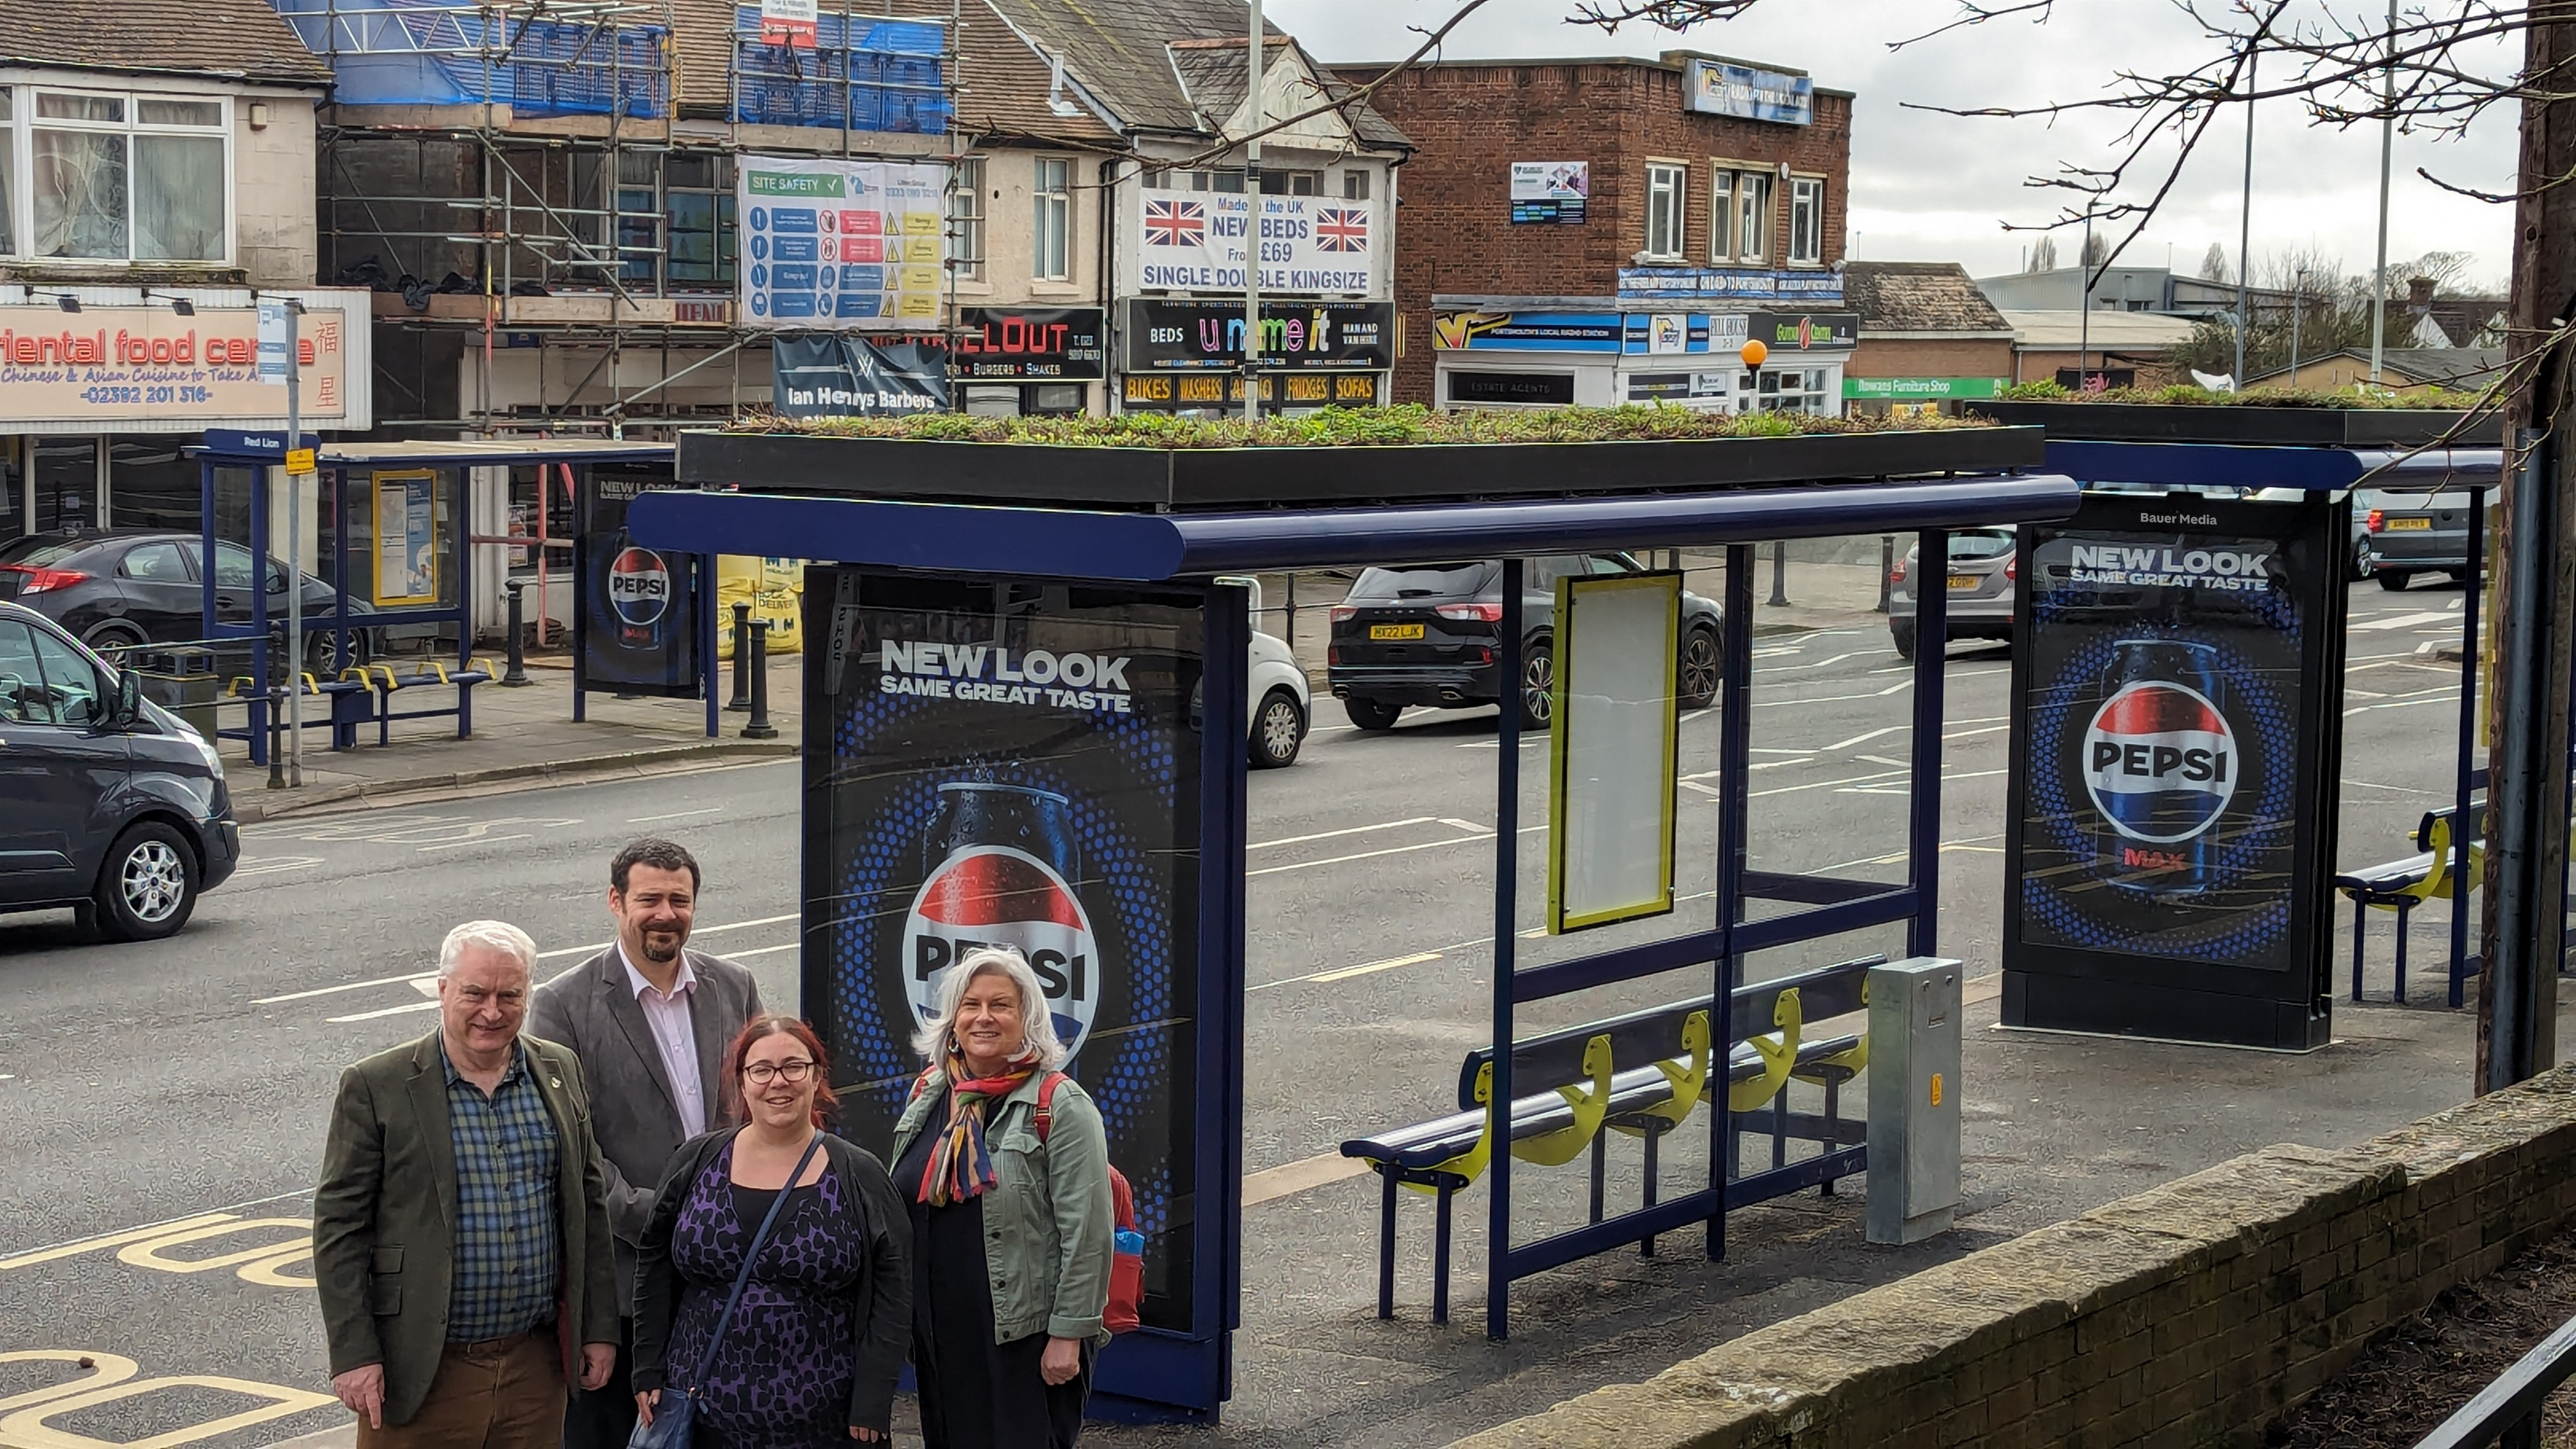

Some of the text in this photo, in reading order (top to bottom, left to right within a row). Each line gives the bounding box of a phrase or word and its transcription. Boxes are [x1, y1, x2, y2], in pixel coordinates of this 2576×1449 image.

[752, 177, 818, 191] SITE SAFETY
[1218, 197, 1304, 214] Made the UK
[1261, 218, 1308, 240] BEDS
[1228, 242, 1292, 263] Fro £69
[1144, 266, 1211, 286] SINGLE
[1291, 270, 1368, 290] KINGSIZE
[1151, 327, 1184, 342] BEDS
[1227, 318, 1304, 352] nme
[1308, 309, 1330, 352] it
[116, 328, 195, 364] food
[1, 367, 63, 383] Chinese
[83, 367, 130, 383] Asian
[132, 367, 190, 383] Cuisine
[1929, 379, 1951, 394] Shop
[146, 386, 174, 404] 201
[788, 387, 935, 411] Ian Henrys Barbers
[1127, 376, 1170, 400] BIKES
[1179, 377, 1223, 401] WASHERS
[1287, 377, 1328, 401] FRIDGES
[1336, 376, 1374, 399] SOFAS
[244, 436, 280, 448] Red Lion
[600, 480, 634, 493] NEW
[2140, 512, 2217, 525] Bauer Media
[2071, 545, 2269, 576] NEW LOOK
[613, 576, 666, 595] PEPSI
[2070, 569, 2269, 592] SAME GREAT TASTE
[881, 640, 1131, 690] NEW LOOK
[880, 675, 1131, 713] SAME GREAT TASTE
[2092, 741, 2227, 783] PEPSI
[2124, 847, 2186, 871] MAX
